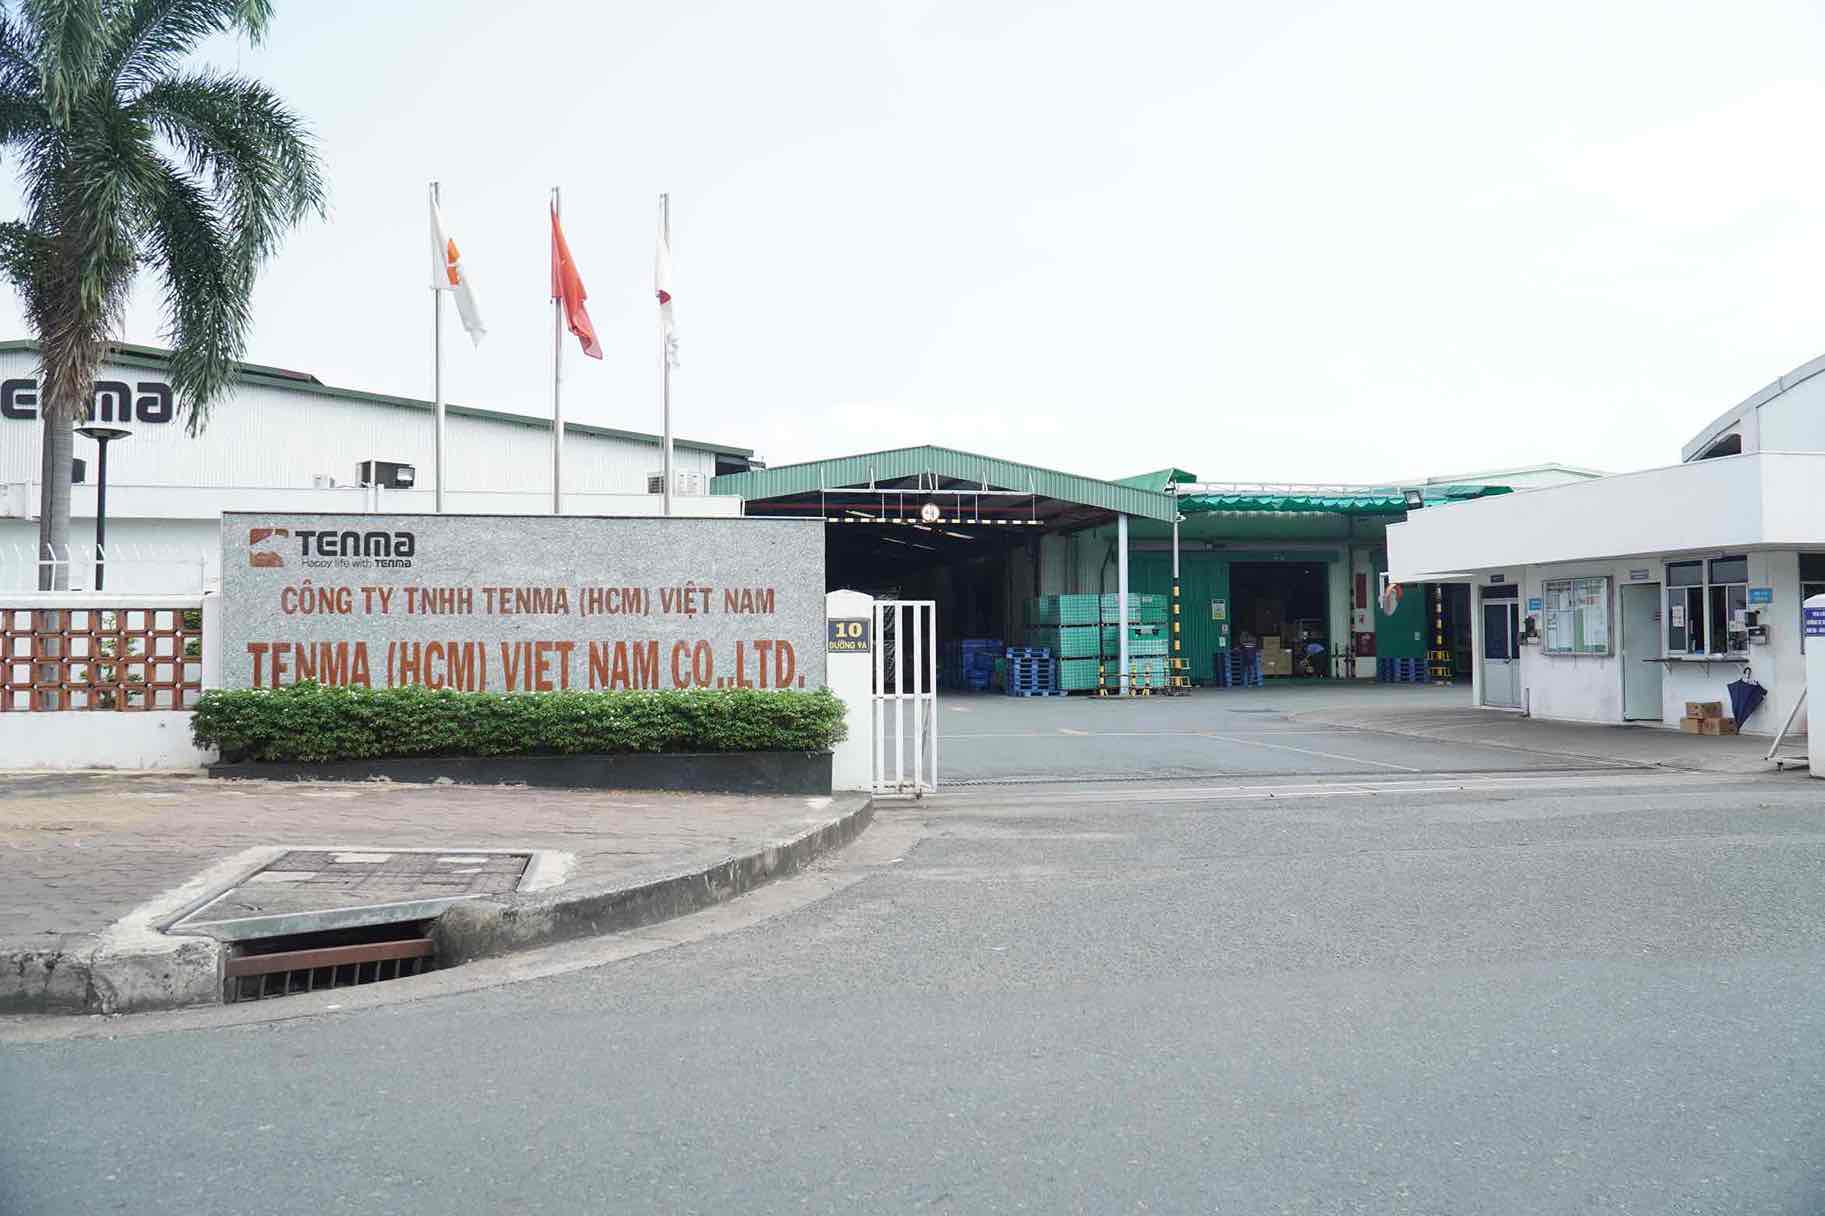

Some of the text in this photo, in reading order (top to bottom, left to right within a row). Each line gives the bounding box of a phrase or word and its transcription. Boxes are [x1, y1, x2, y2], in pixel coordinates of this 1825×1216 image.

[302, 559, 333, 569] Happy
[335, 559, 350, 568] life
[352, 559, 373, 568] with
[281, 579, 775, 619] CÔNG TY TNHH TENMA (HCM) VIỆT NAM
[835, 622, 863, 638] 10
[247, 641, 371, 689] TENMA
[387, 640, 486, 691] (HCM)
[500, 640, 575, 691] VIET
[588, 640, 660, 690] NAM
